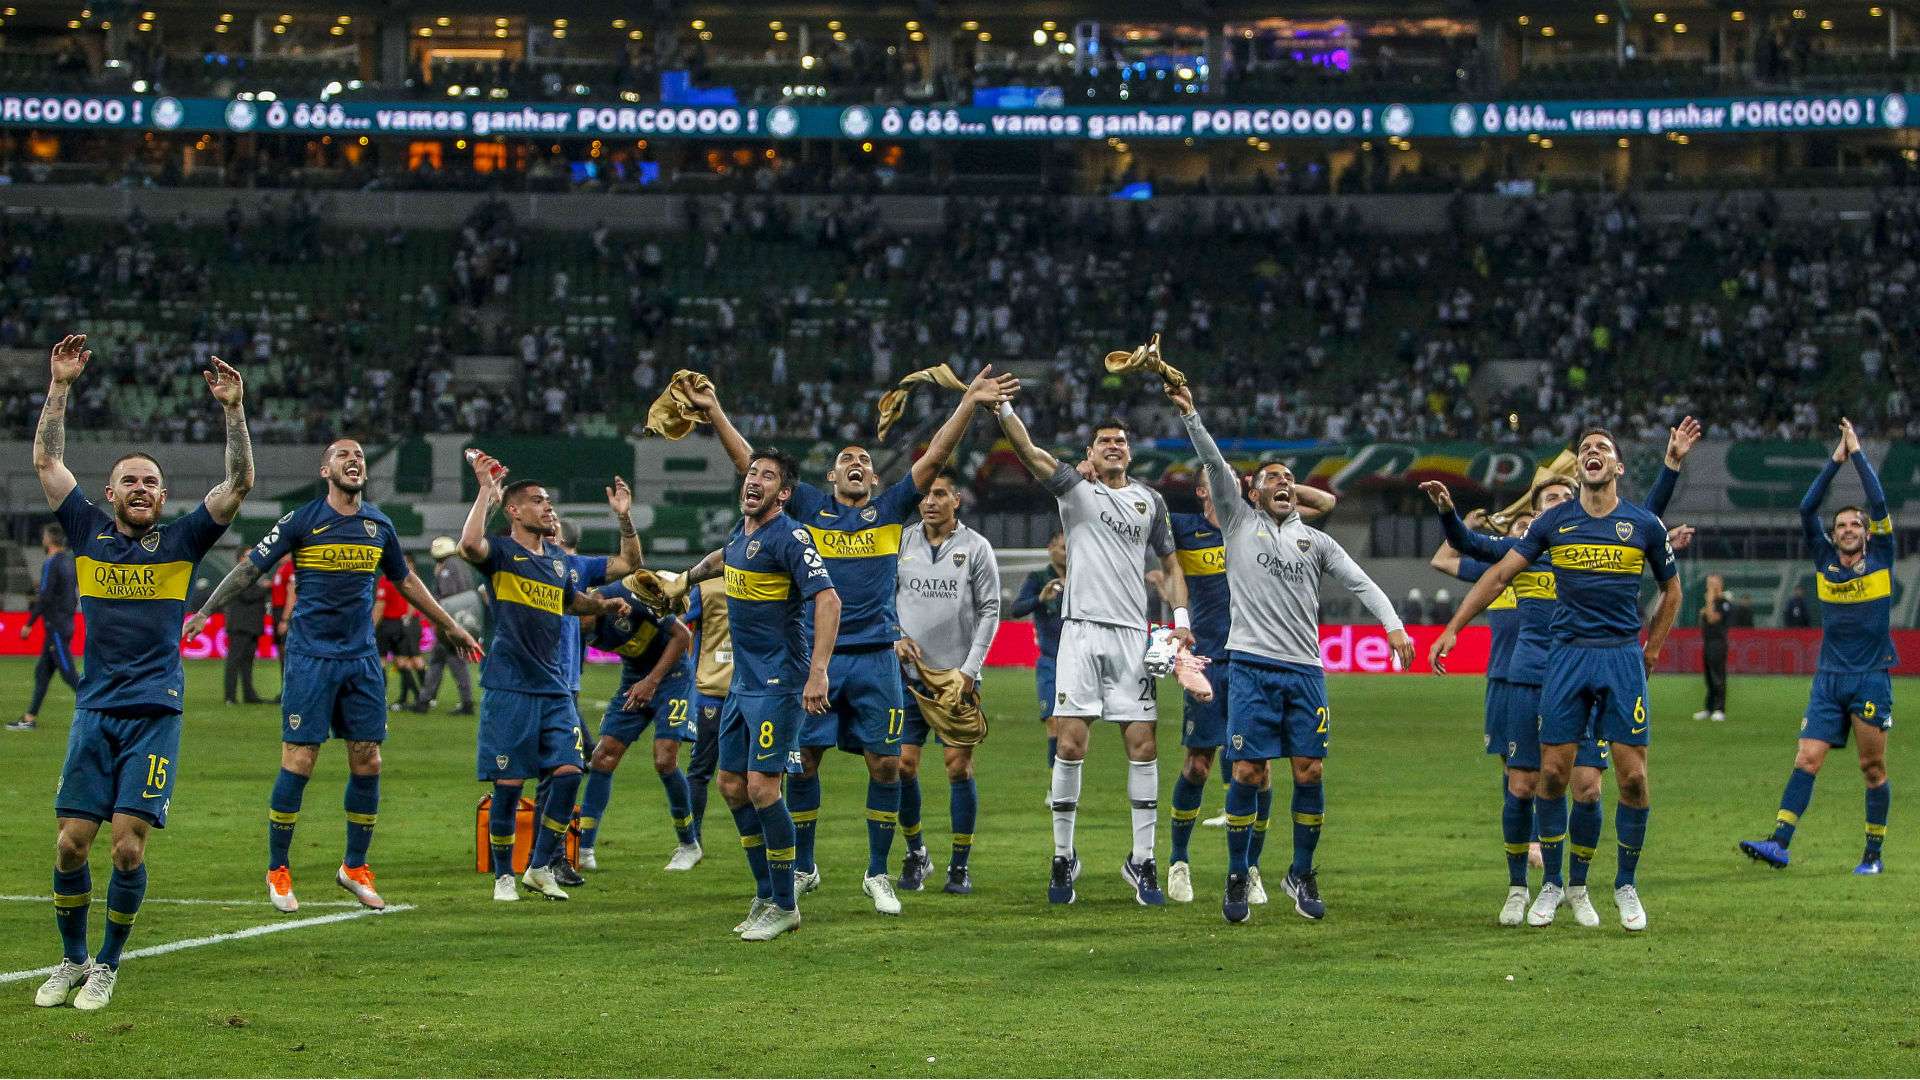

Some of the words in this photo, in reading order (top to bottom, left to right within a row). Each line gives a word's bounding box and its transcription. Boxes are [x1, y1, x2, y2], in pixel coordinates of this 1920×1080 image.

[0, 98, 125, 122] RCOOOO
[1570, 109, 1643, 130] vamos
[1648, 103, 1725, 133] ganhar
[1730, 99, 1861, 127] PORCOOOO
[376, 110, 466, 129] vamos
[472, 108, 569, 134] ganhar
[576, 108, 741, 132] PORCOOOO
[992, 115, 1081, 133] vamos
[1087, 111, 1184, 137] ganhar
[1192, 109, 1355, 132] PORCOOOO
[1100, 511, 1141, 538] QATAR
[823, 532, 875, 547] QATAR
[322, 548, 374, 563] QATAR
[836, 545, 876, 555] AIRWAYS
[1565, 547, 1623, 562] QATAR
[336, 561, 374, 570] AIRWAYS
[1257, 552, 1304, 575] QATAR
[95, 566, 156, 586] QATAR
[725, 569, 747, 588] ATAR
[910, 578, 958, 592] QATAR
[1268, 567, 1304, 584] AIRWAYS
[106, 585, 156, 597] AIRWAYS
[520, 582, 560, 602] QATAR
[921, 591, 958, 600] AIRWAYS
[531, 597, 559, 611] AIRWAYS
[668, 699, 688, 721] 22
[1633, 696, 1646, 724] 6
[1863, 700, 1876, 719] 5
[758, 720, 776, 749] 8
[146, 753, 170, 789] 15
